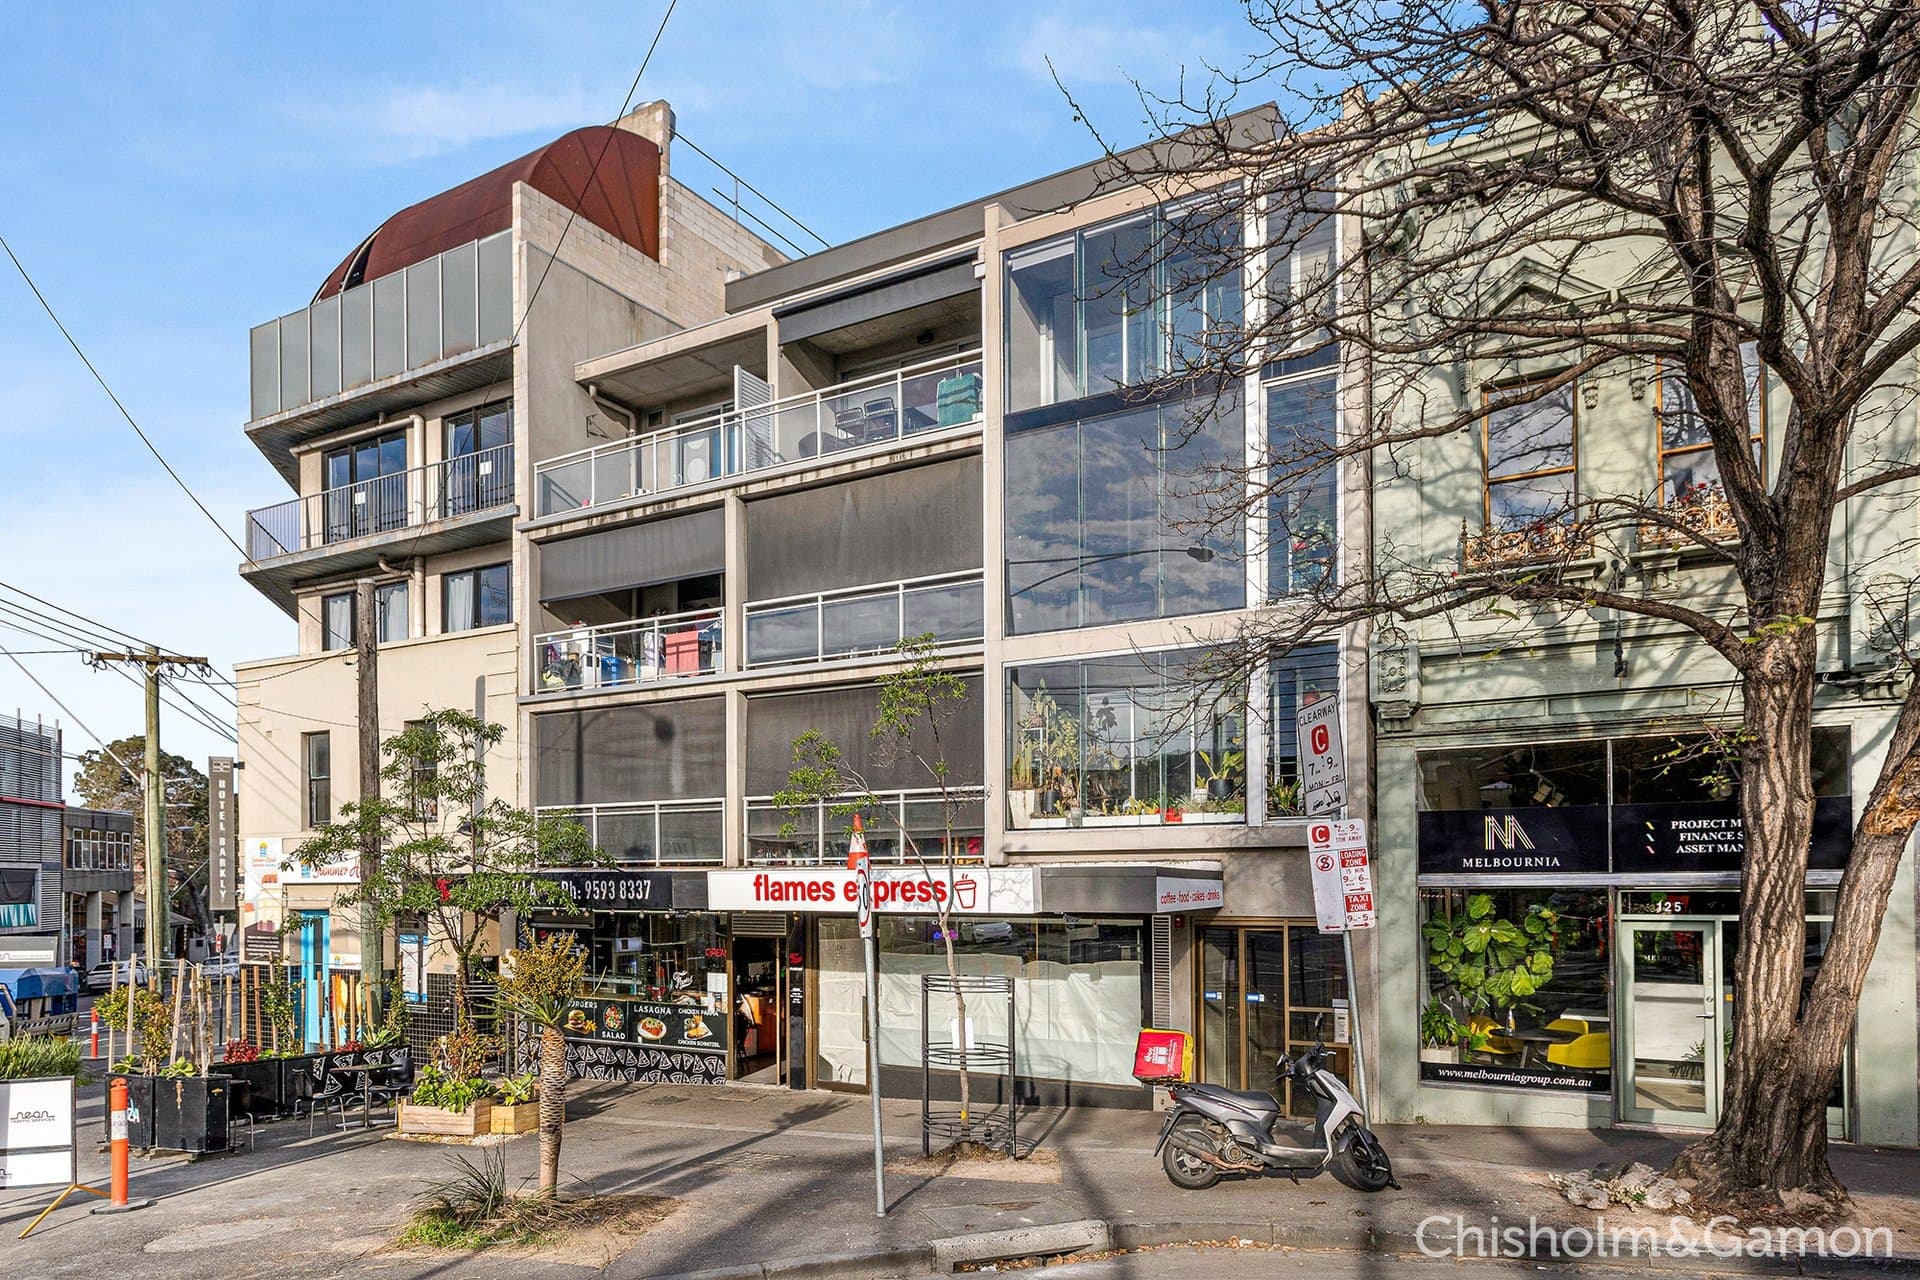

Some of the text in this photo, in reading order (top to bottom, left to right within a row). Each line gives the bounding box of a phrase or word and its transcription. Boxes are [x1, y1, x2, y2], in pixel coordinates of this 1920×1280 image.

[1299, 703, 1336, 727] CLEARWAY
[1315, 728, 1327, 752] C
[1671, 819, 1742, 830] PROJECT M
[218, 779, 226, 900] HOTEL BARKLY
[1679, 831, 1736, 842] FINANCE
[1676, 843, 1744, 854] ASSET MAN
[1340, 850, 1365, 859] LOADING
[1345, 858, 1363, 867] ZONE
[1462, 856, 1561, 868] MELBOURNIA
[585, 880, 615, 900] 9593
[619, 879, 651, 900] 8337
[753, 874, 947, 909] flames epress
[1160, 888, 1220, 905] coffee food cakes drinks
[1347, 894, 1369, 904] TAXI
[1351, 902, 1368, 911] ZONE
[1656, 900, 1682, 912] 125
[705, 948, 727, 958] OPEN
[633, 1004, 672, 1016] LASAGNA
[602, 1030, 626, 1040] SALAD
[677, 1039, 697, 1047] CHICKEN
[1438, 1067, 1593, 1088] www.melbourniagroup.com.au
